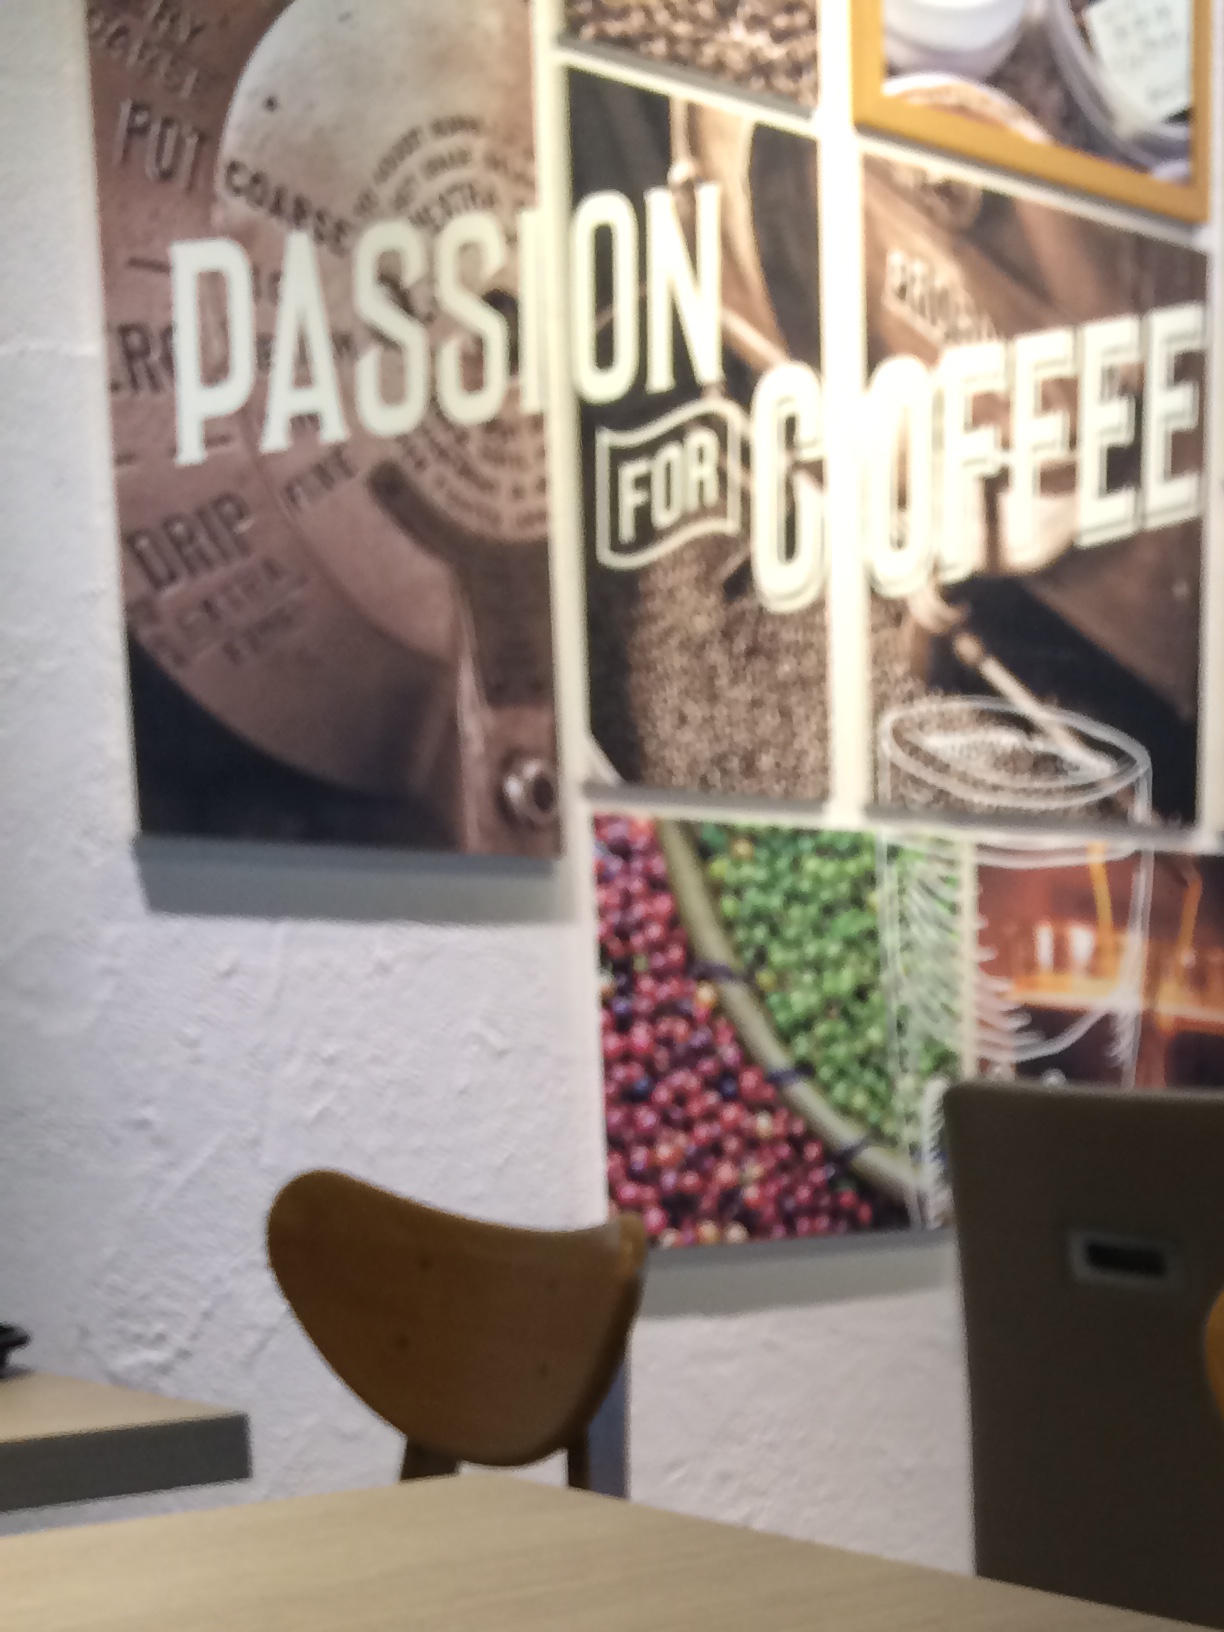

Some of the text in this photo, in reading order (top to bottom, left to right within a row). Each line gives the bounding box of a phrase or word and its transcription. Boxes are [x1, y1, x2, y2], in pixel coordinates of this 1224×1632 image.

[118, 100, 208, 196] POT
[223, 158, 352, 259] COARSE
[170, 183, 723, 467] PASSION
[617, 428, 720, 545] FOR
[750, 303, 1206, 615] COFFEE
[124, 492, 254, 592] DRIP
